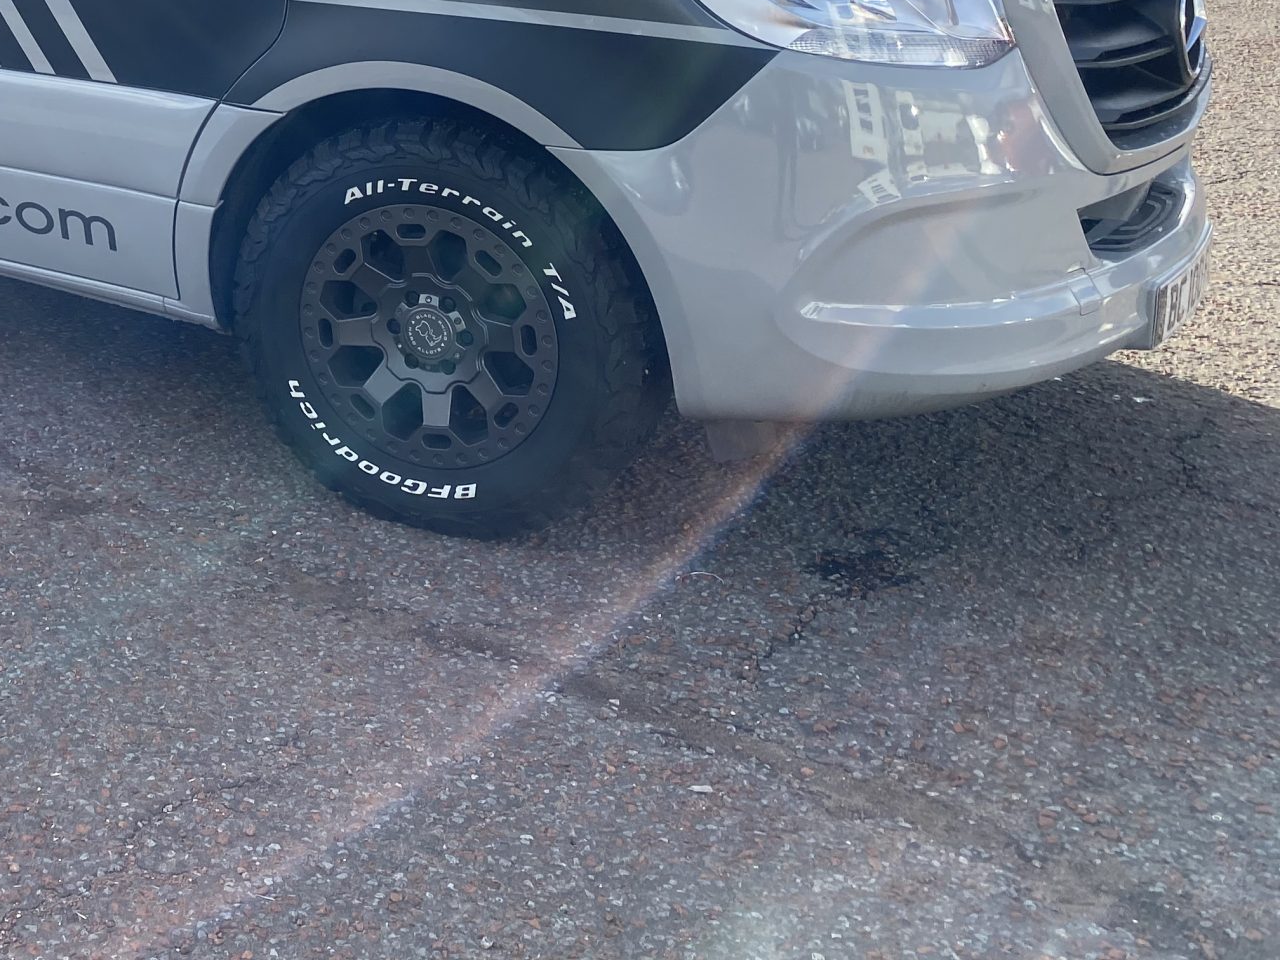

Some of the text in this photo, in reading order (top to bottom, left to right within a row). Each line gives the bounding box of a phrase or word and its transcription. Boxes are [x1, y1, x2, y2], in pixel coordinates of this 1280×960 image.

[344, 178, 578, 320] All-Terrain T/A
[287, 379, 478, 500] BFGoodrich
